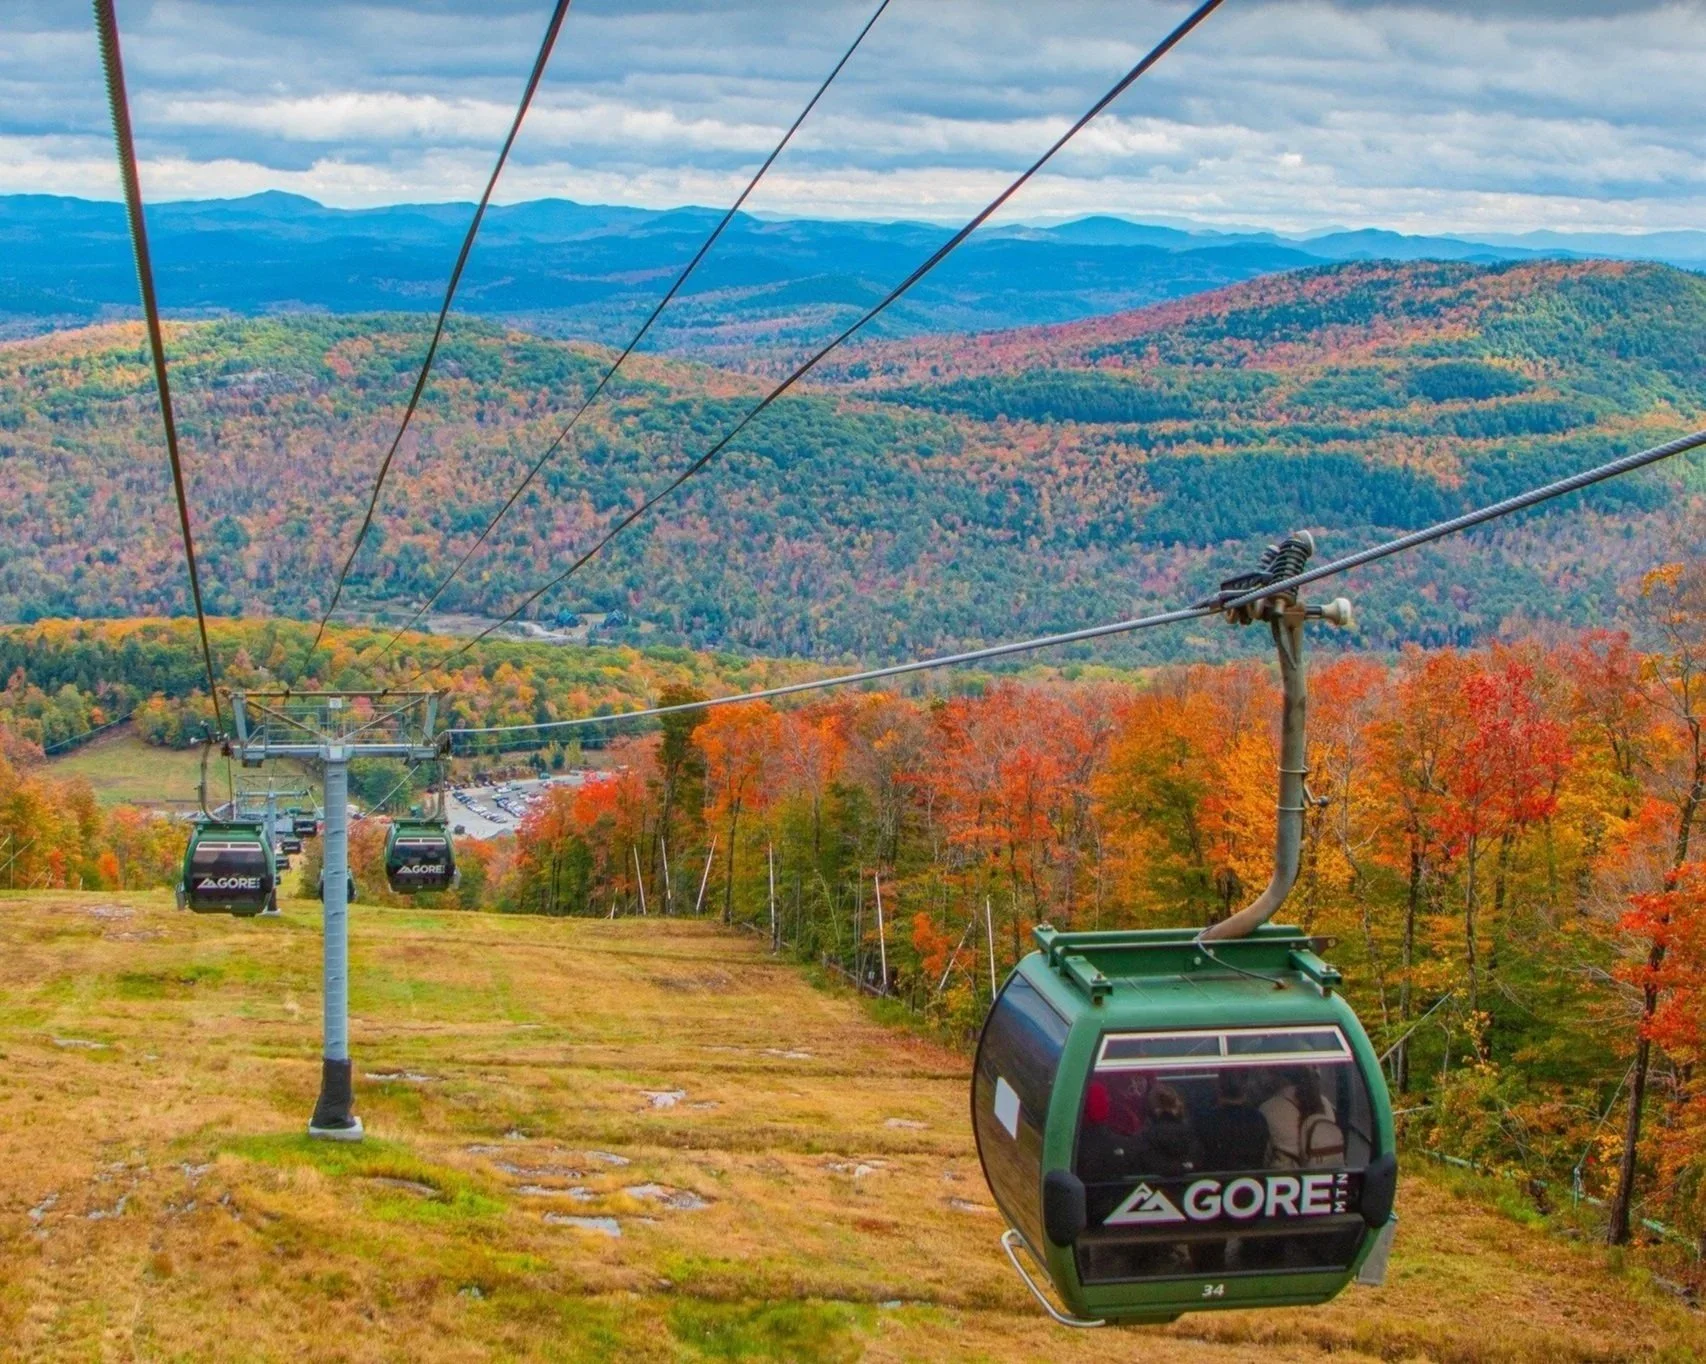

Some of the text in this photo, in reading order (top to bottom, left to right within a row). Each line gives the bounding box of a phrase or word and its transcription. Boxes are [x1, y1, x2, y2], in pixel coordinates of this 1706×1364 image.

[412, 864, 443, 874] GORE
[217, 877, 257, 889] GORE
[1183, 1174, 1333, 1220] GORE
[1334, 1173, 1348, 1213] MTN
[1201, 1284, 1225, 1297] 34
